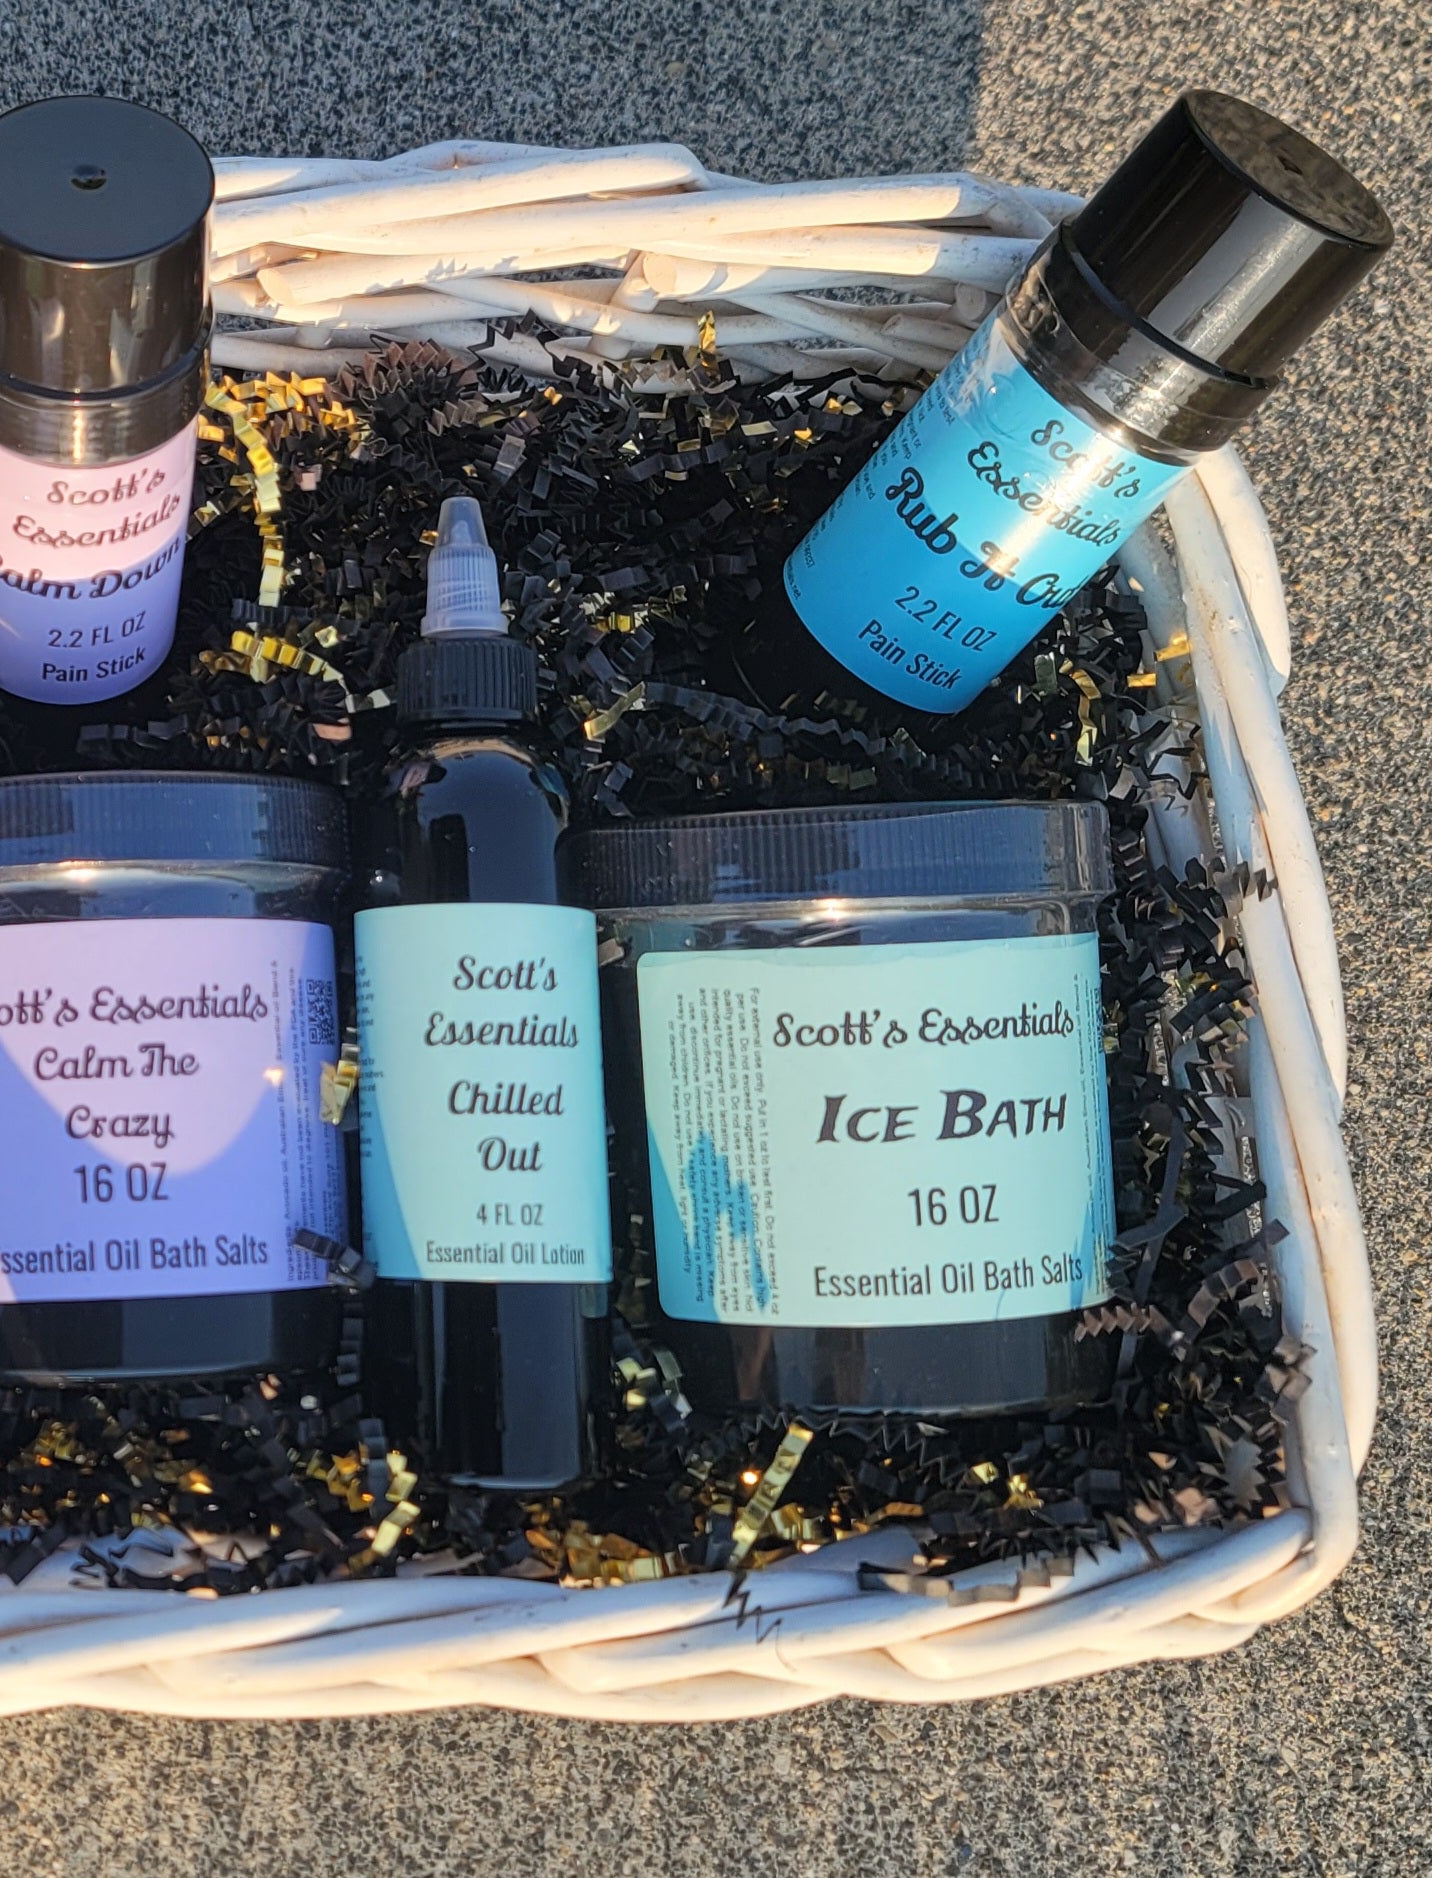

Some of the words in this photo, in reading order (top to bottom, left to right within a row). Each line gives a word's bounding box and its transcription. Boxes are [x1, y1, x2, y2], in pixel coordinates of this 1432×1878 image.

[1030, 419, 1140, 498] Scott's
[47, 468, 165, 505] Scott's
[968, 441, 1118, 547] Essentials
[13, 494, 180, 549] Essentials
[885, 467, 959, 556] Rub
[89, 537, 180, 598] Down
[48, 629, 82, 648] 2.2
[92, 626, 113, 646] FL
[122, 611, 146, 637] OZ
[894, 585, 937, 623] 2.2
[934, 612, 964, 639] FL
[962, 626, 997, 652] OZ
[42, 663, 87, 682] Pain
[95, 646, 146, 678] Stick
[858, 619, 909, 665] Pain
[905, 653, 964, 691] Stick
[452, 955, 558, 992] Scott's
[89, 983, 268, 1024] Essentials
[749, 987, 760, 1005] For
[424, 1011, 579, 1048] Essentials
[772, 1009, 908, 1049] Scott's
[918, 1000, 1075, 1047] Essentials
[33, 1046, 133, 1082] Calm
[139, 1043, 199, 1078] The
[448, 1079, 565, 1116] Chilled
[64, 1103, 175, 1149] Crazy
[477, 1136, 543, 1173] Out
[74, 1164, 114, 1204] 16
[125, 1162, 169, 1202] OZ
[476, 1203, 487, 1223] 4
[495, 1203, 514, 1226] FL
[521, 1203, 543, 1226] OZ
[907, 1187, 947, 1227] 16
[959, 1184, 1000, 1225] OZ
[105, 1239, 140, 1271] Oil
[151, 1237, 206, 1269] Bath
[215, 1235, 268, 1267] Salts
[426, 1240, 504, 1264] Essential
[511, 1241, 535, 1264] Oil
[542, 1242, 585, 1265] Lotion
[814, 1265, 932, 1299] Essential
[942, 1262, 975, 1294] Oil
[984, 1258, 1035, 1291] Bath
[1041, 1252, 1083, 1286] Salts
